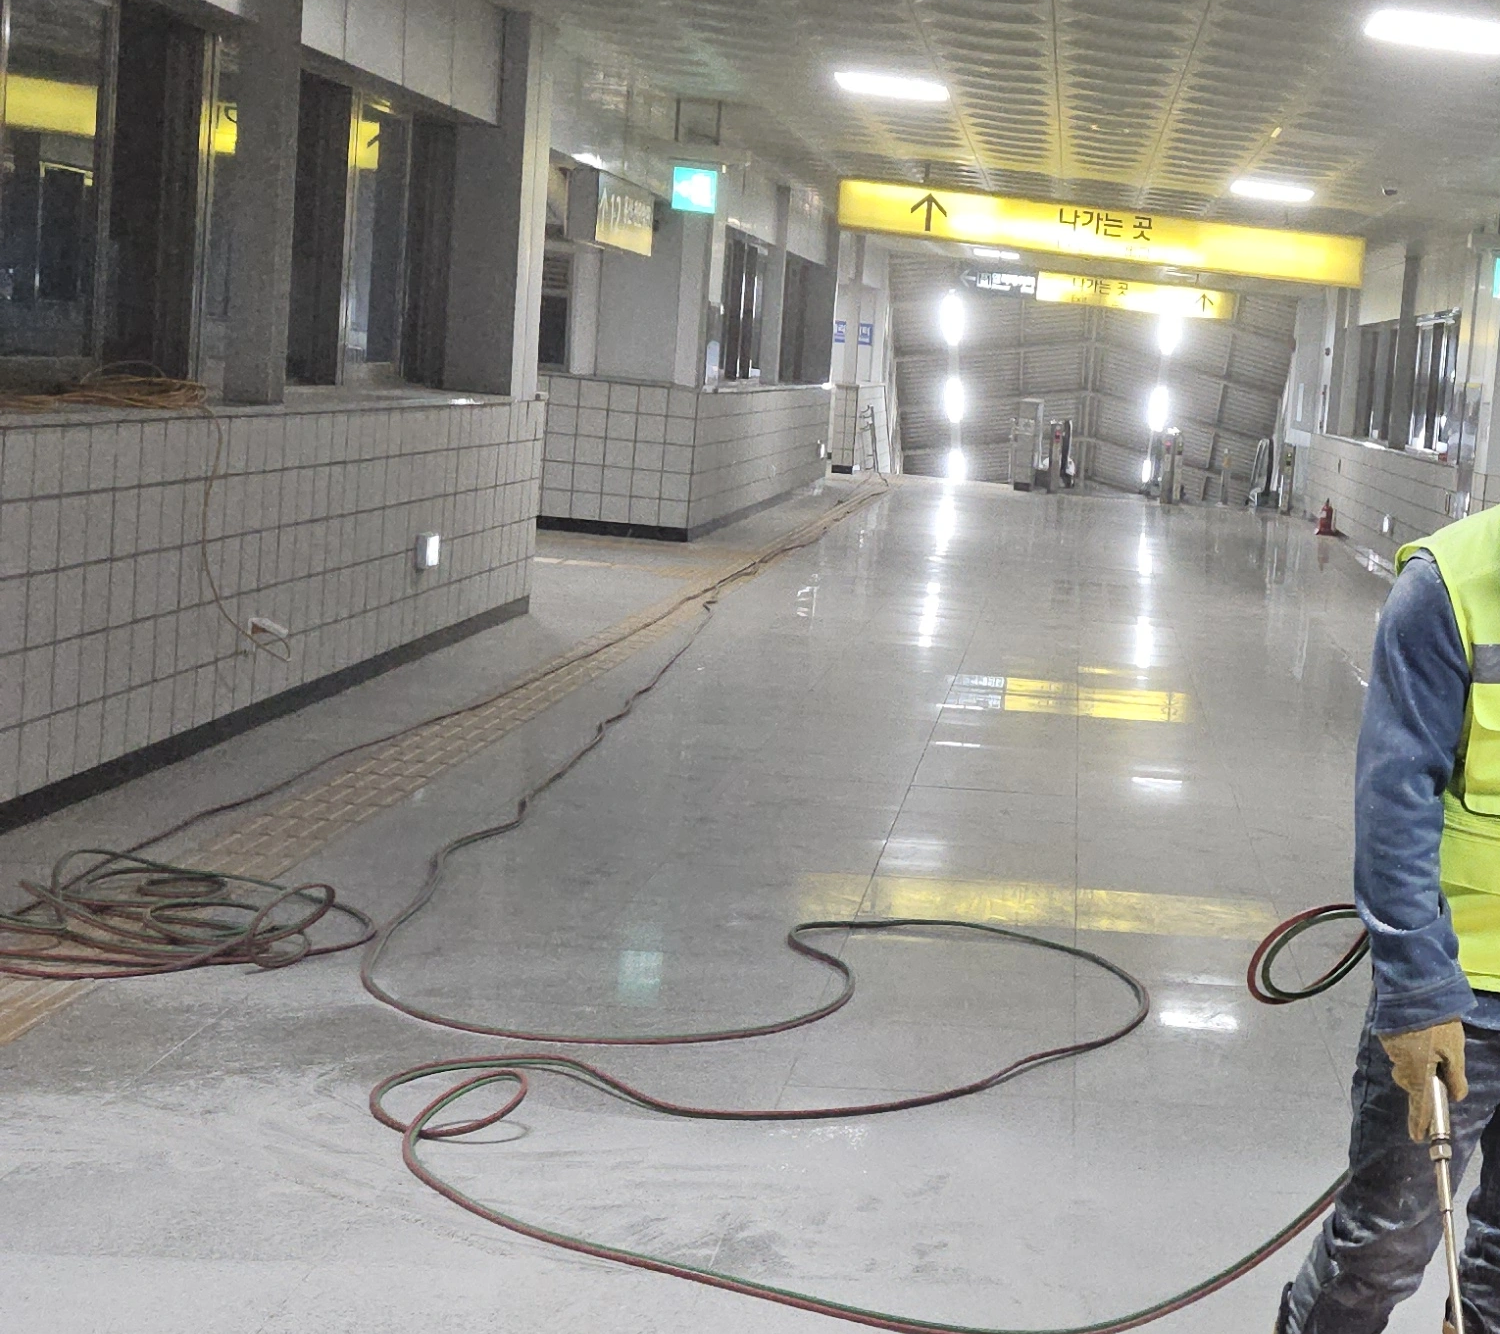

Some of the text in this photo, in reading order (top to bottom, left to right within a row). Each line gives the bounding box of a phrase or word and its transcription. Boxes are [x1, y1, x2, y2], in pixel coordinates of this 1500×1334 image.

[1059, 208, 1153, 241] 나가는 곳
[1072, 277, 1129, 296] 나가는 곳
